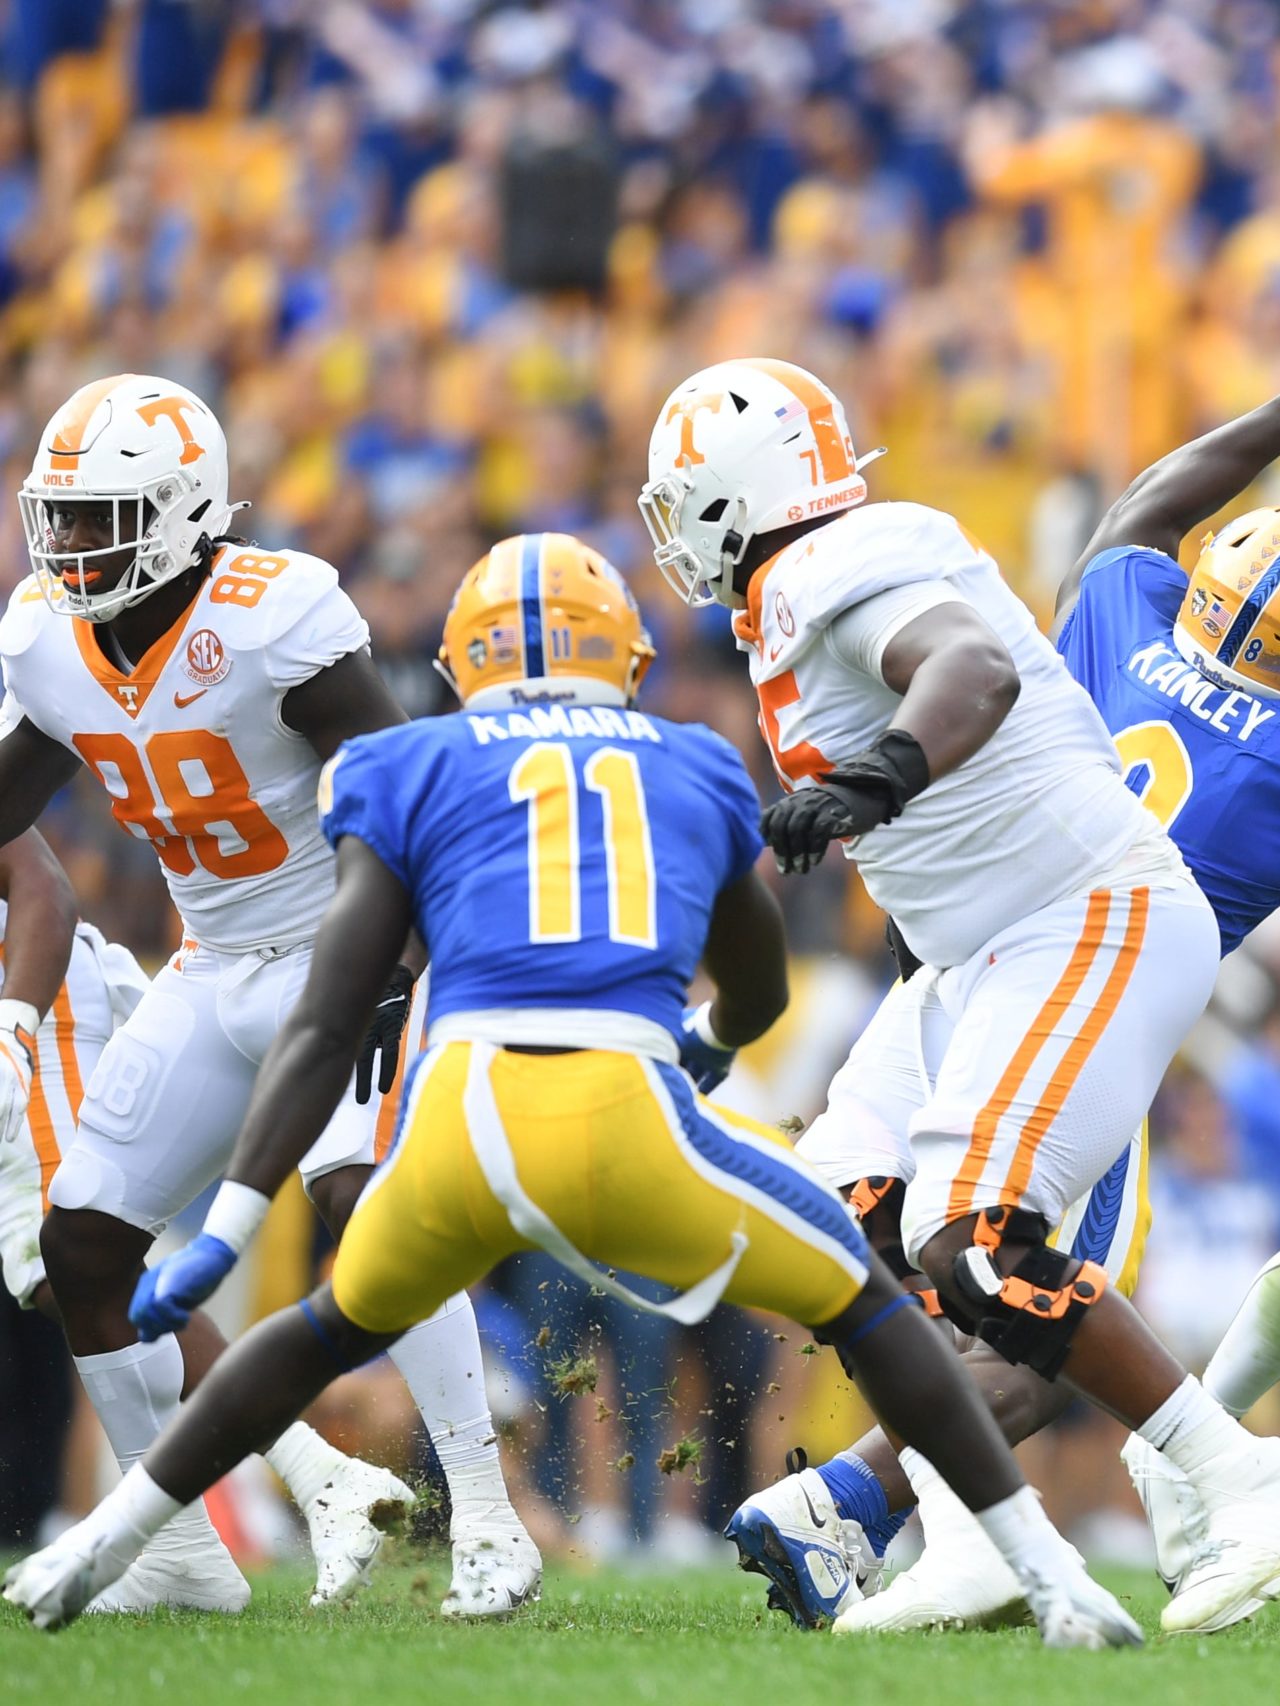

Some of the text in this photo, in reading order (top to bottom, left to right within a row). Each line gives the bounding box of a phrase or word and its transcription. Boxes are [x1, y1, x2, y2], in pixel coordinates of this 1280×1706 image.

[136, 396, 207, 465] T
[43, 474, 75, 487] VOLS
[799, 449, 818, 486] 7
[210, 553, 290, 609] 88
[190, 631, 222, 671] SEC
[551, 628, 571, 660] 11
[1243, 637, 1264, 663] 8
[187, 667, 226, 684] GRADUATE
[1127, 641, 1277, 742] KANCEY
[118, 685, 140, 711] T
[71, 728, 290, 880] 88
[508, 741, 658, 951] 11
